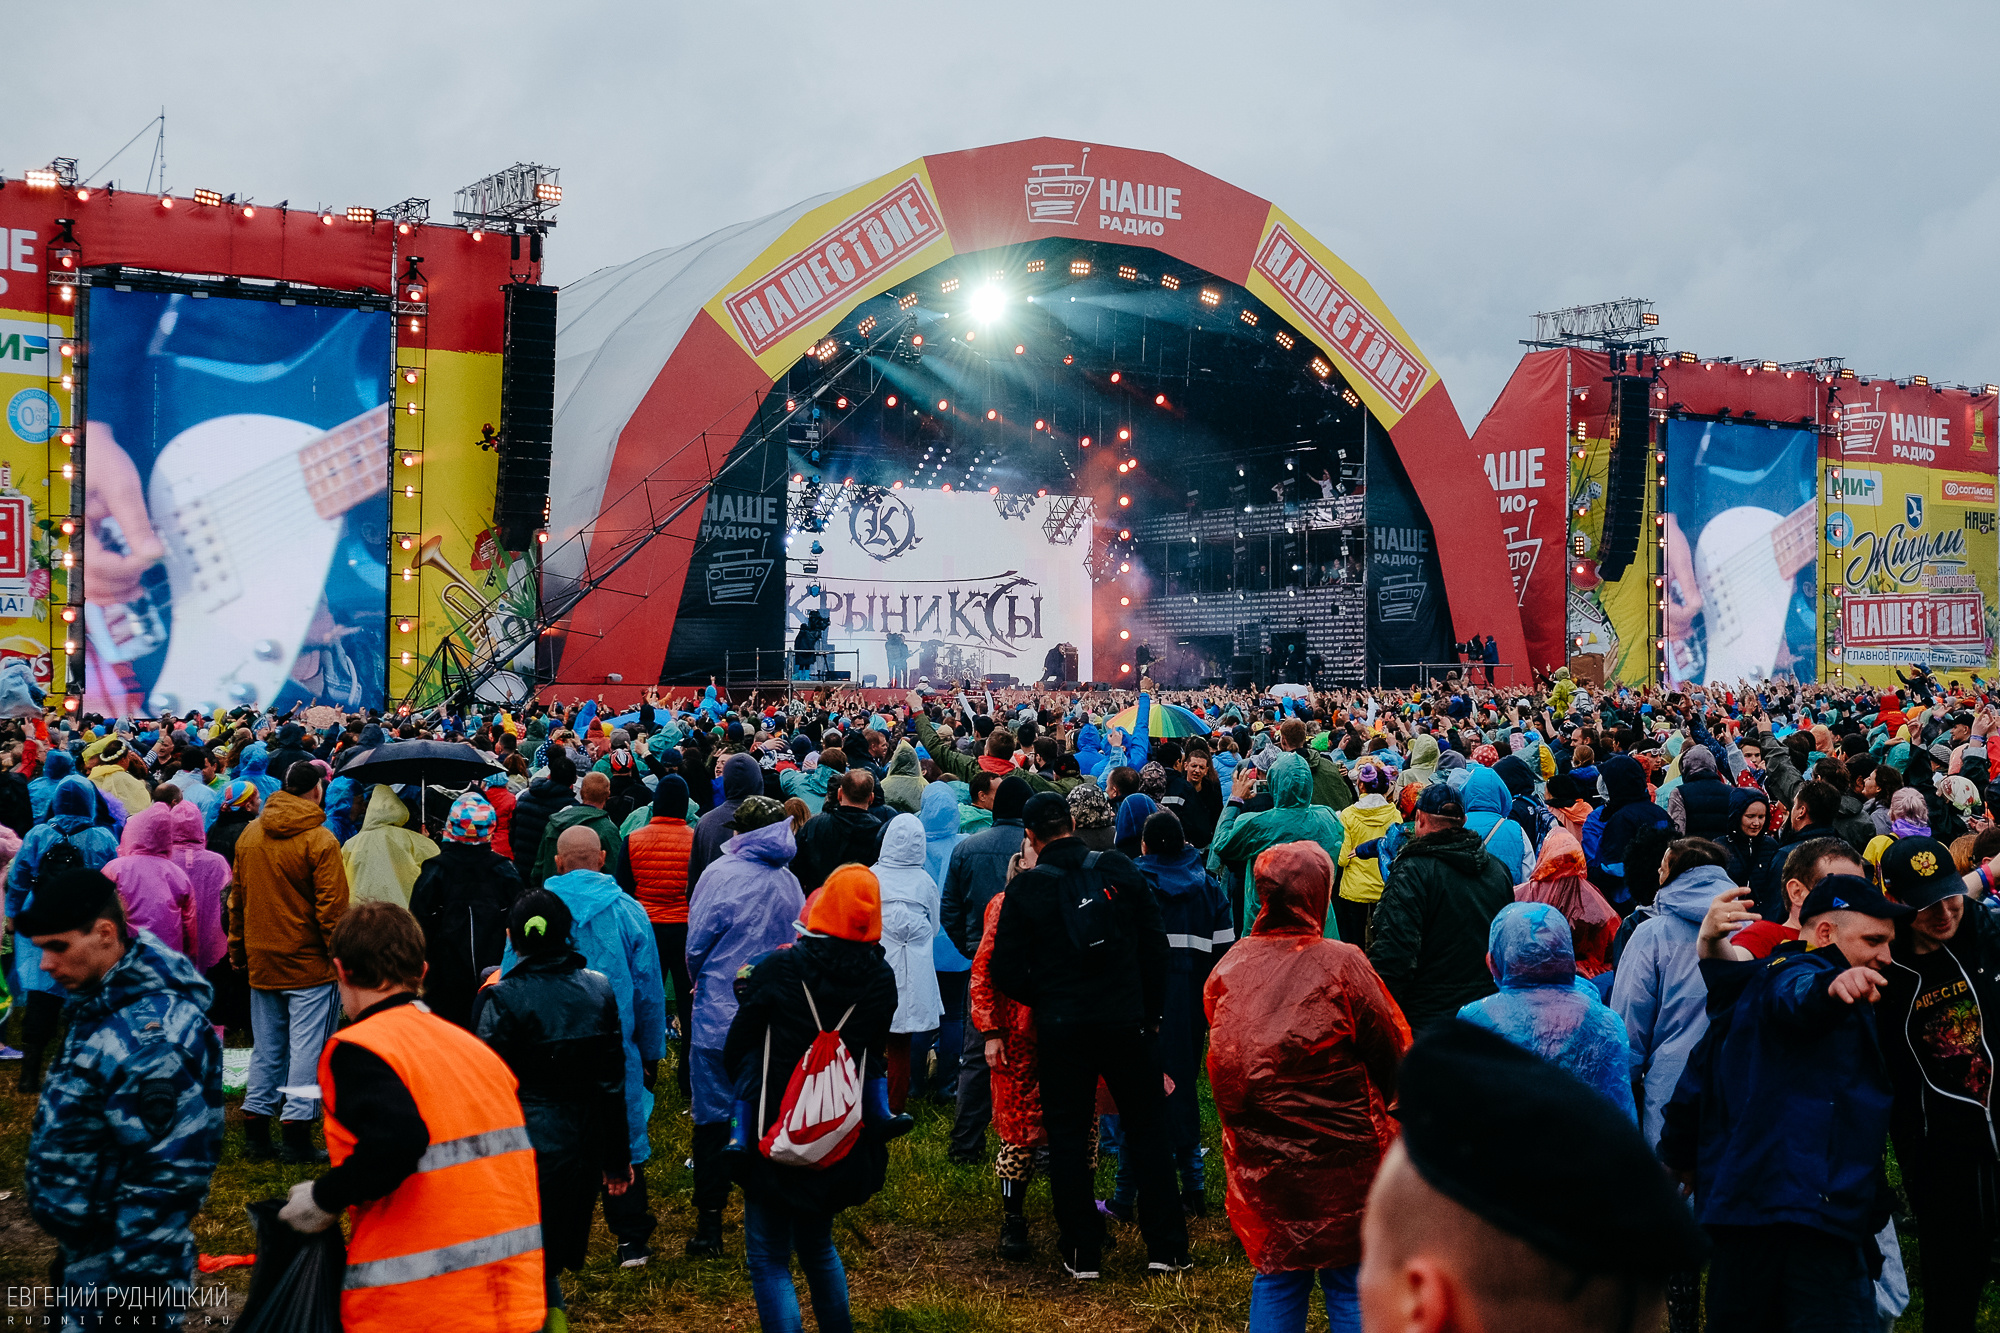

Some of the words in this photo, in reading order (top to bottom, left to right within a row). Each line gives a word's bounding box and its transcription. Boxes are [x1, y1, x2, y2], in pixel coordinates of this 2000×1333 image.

[1100, 178, 1182, 220] НАШЕ
[1100, 214, 1165, 236] РАДИО
[739, 193, 930, 341] НАШЕСТВИЕ
[1264, 238, 1416, 398] НАШЕСТВИЕ
[1890, 412, 1950, 446] НАШЕ
[1892, 444, 1936, 462] РАДИО
[1480, 447, 1546, 491] АШЕ
[1832, 477, 1876, 496] МИР
[1958, 486, 1993, 496] СОГЛАСИЕ
[702, 494, 778, 525] НАШЕ
[1965, 511, 1995, 531] НАШЕ
[702, 525, 762, 541] РАДИО
[1373, 526, 1429, 552] НАШЕ
[1374, 553, 1417, 567] РАДИО
[1845, 523, 1967, 588] Жигули
[1850, 601, 1977, 637] НАШЕСТВИЕ
[1847, 650, 1890, 661] ГЛАВНОЕ
[1892, 651, 1957, 664] ПРИКЛЮЧЕНИЕ
[1915, 980, 1969, 1011] АШЕСТВ
